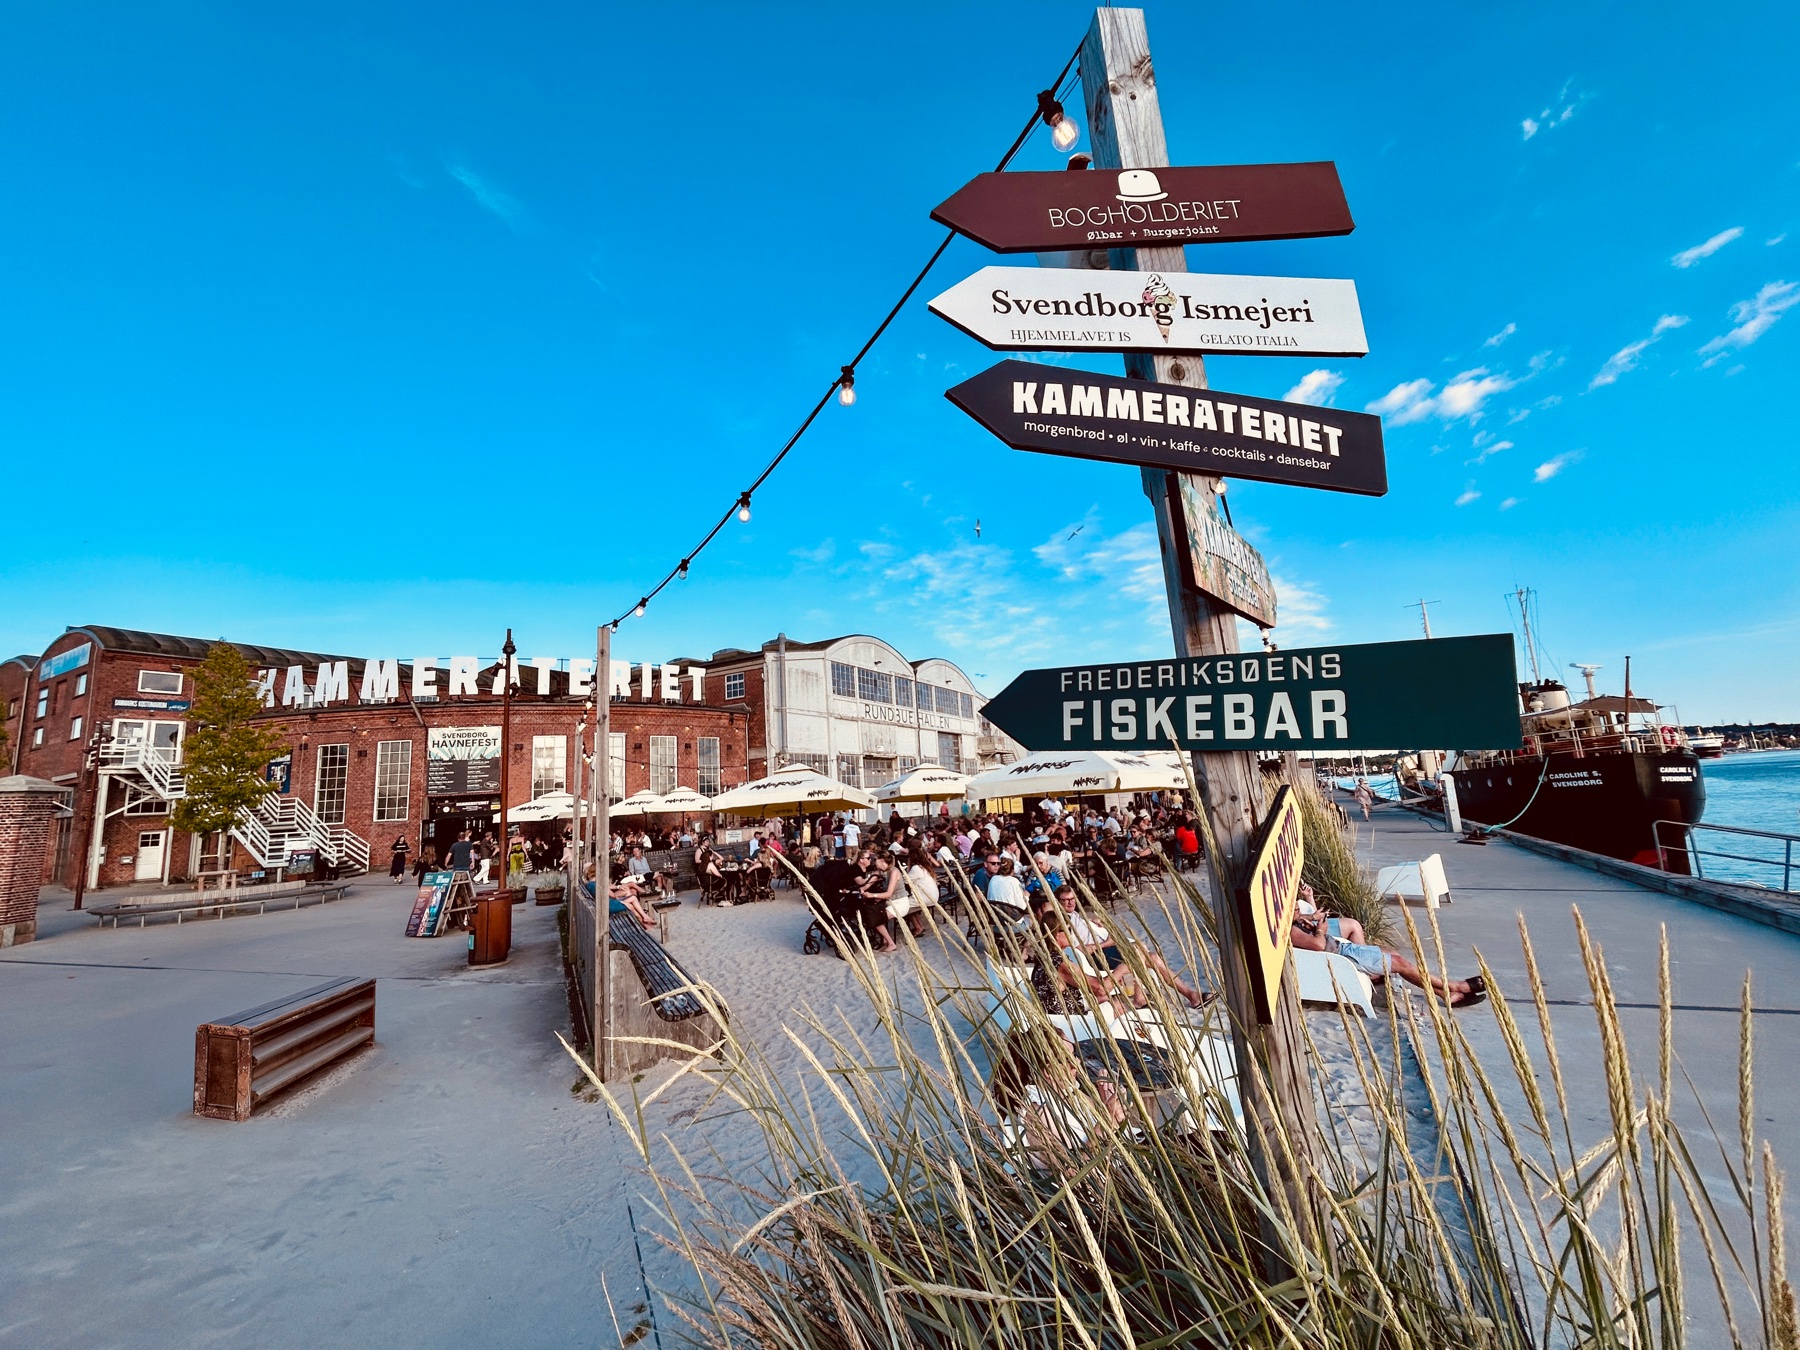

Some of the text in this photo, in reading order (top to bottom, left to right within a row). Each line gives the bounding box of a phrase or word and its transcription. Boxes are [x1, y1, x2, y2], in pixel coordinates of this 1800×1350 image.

[1048, 200, 1241, 228] BOGHOLDERIET
[1087, 231, 1124, 241] Ølbar
[1143, 225, 1220, 238] Burgerjoint
[991, 289, 1314, 329] Svendborg Ismejeri
[1010, 329, 1132, 343] HJEMMELAVET IS
[1200, 333, 1299, 347] GELATO ITALIA
[1013, 381, 1343, 457] KAMMERATERIET
[1024, 421, 1331, 470] morgenbrød øl vin kaffe cocktails dansebar
[256, 656, 707, 708] KAMMERATERIET
[1060, 653, 1341, 692] FREDERIKSØENS
[1062, 689, 1348, 741] FISKEBAR
[432, 739, 498, 748] HAVNEFEST
[1549, 771, 1590, 780] CAROLINE
[1552, 778, 1604, 788] SVENDBORG
[1262, 802, 1299, 949] CAMPETTO
